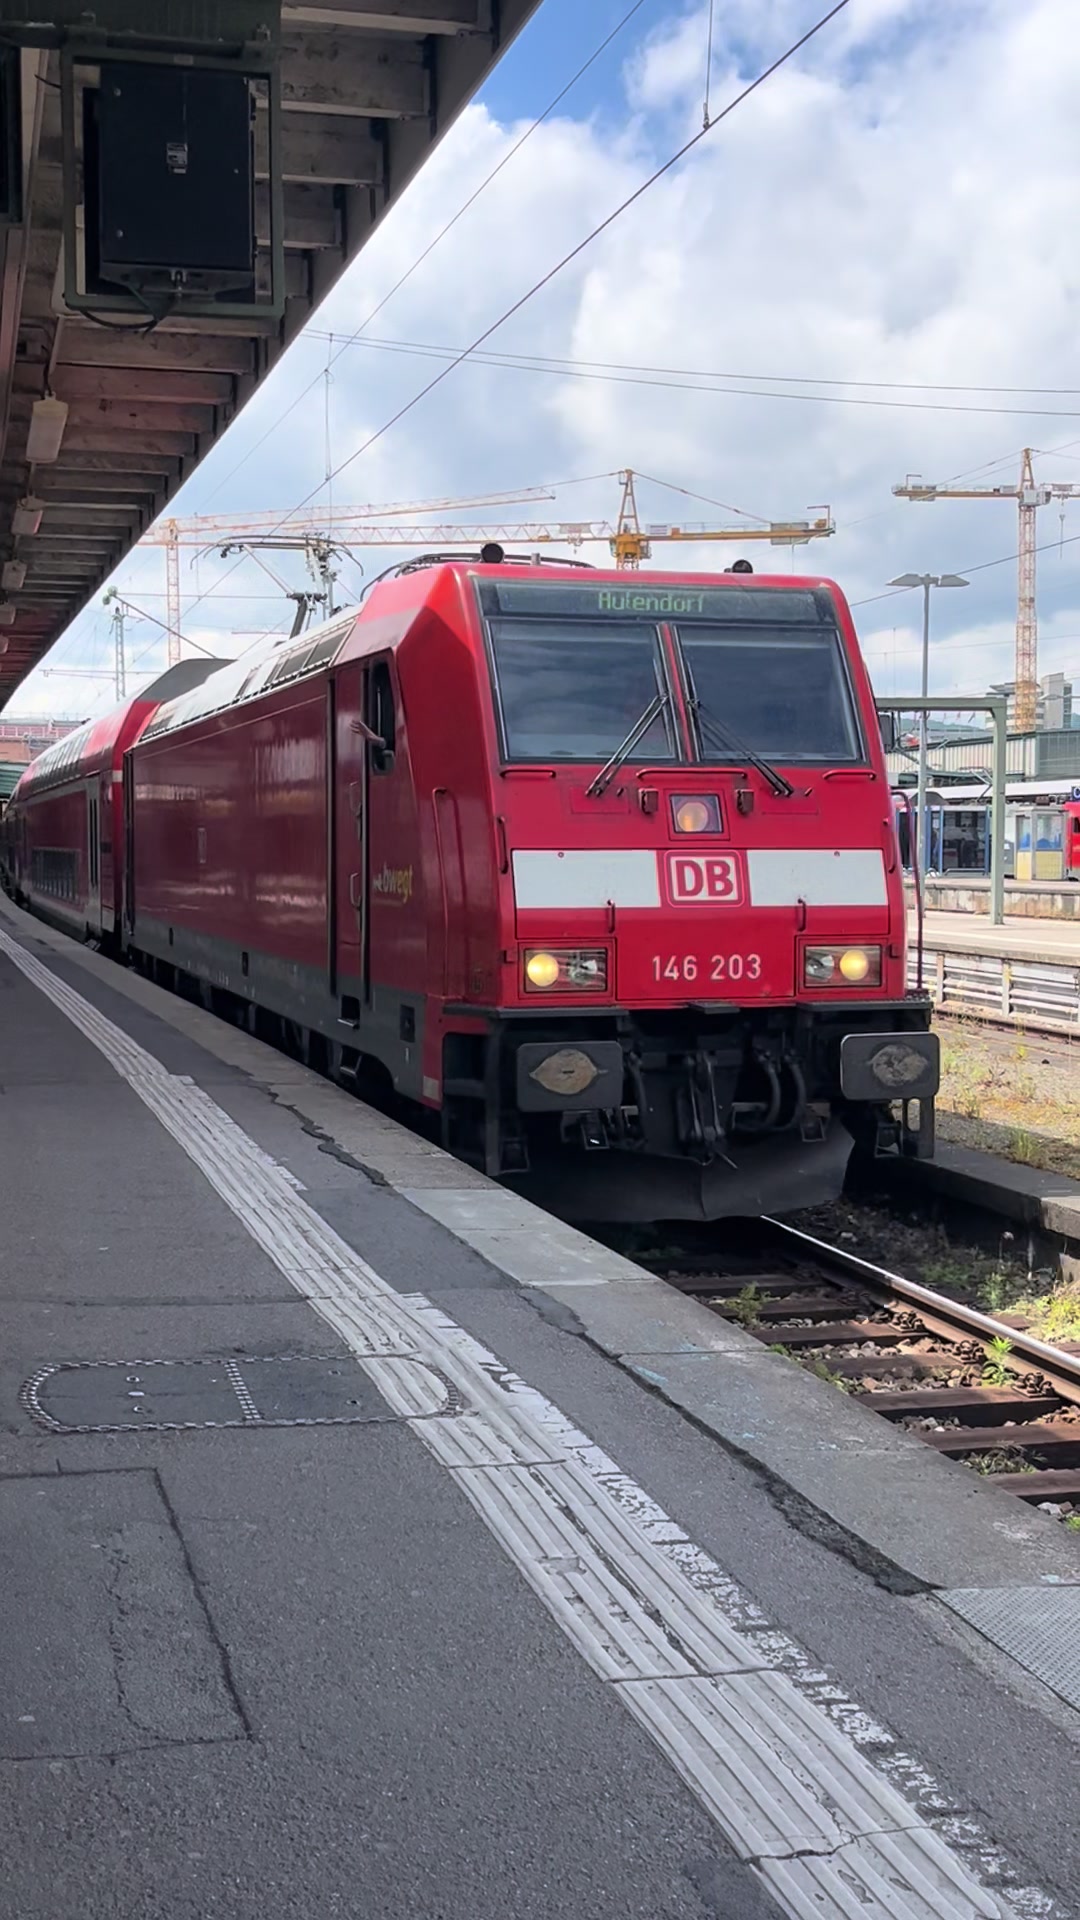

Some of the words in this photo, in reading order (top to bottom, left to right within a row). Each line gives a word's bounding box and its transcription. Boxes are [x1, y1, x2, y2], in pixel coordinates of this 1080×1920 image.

[675, 860, 734, 897] DB
[652, 955, 697, 981] 146
[710, 953, 761, 980] 203
